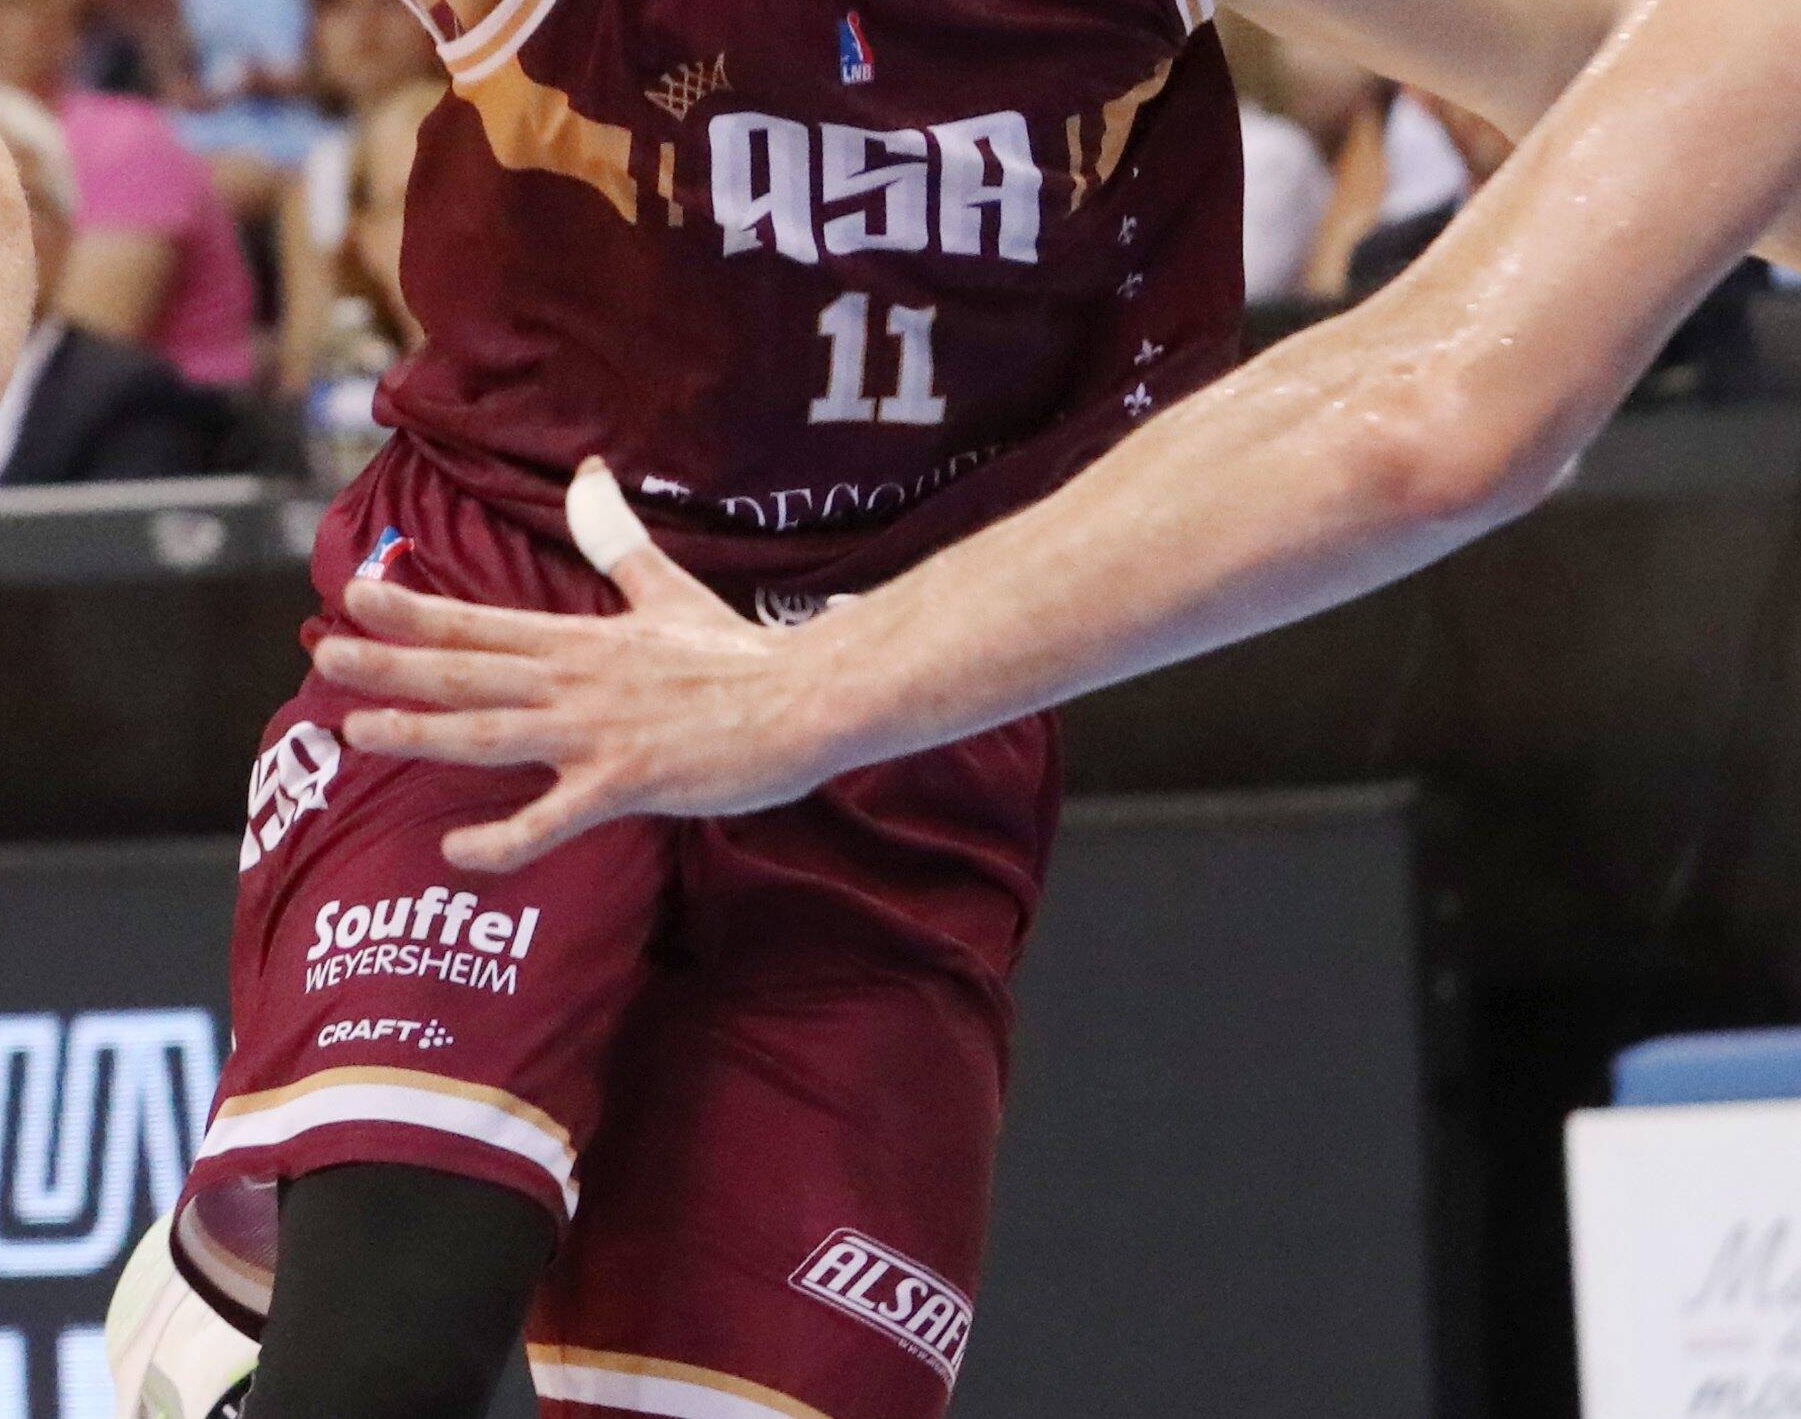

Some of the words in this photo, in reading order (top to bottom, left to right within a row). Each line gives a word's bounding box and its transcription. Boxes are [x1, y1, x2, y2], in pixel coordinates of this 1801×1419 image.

[807, 291, 946, 426] 11
[306, 886, 541, 960] Souffel
[305, 943, 518, 996] WEYERSHEIM
[317, 1019, 423, 1048] CRAFT
